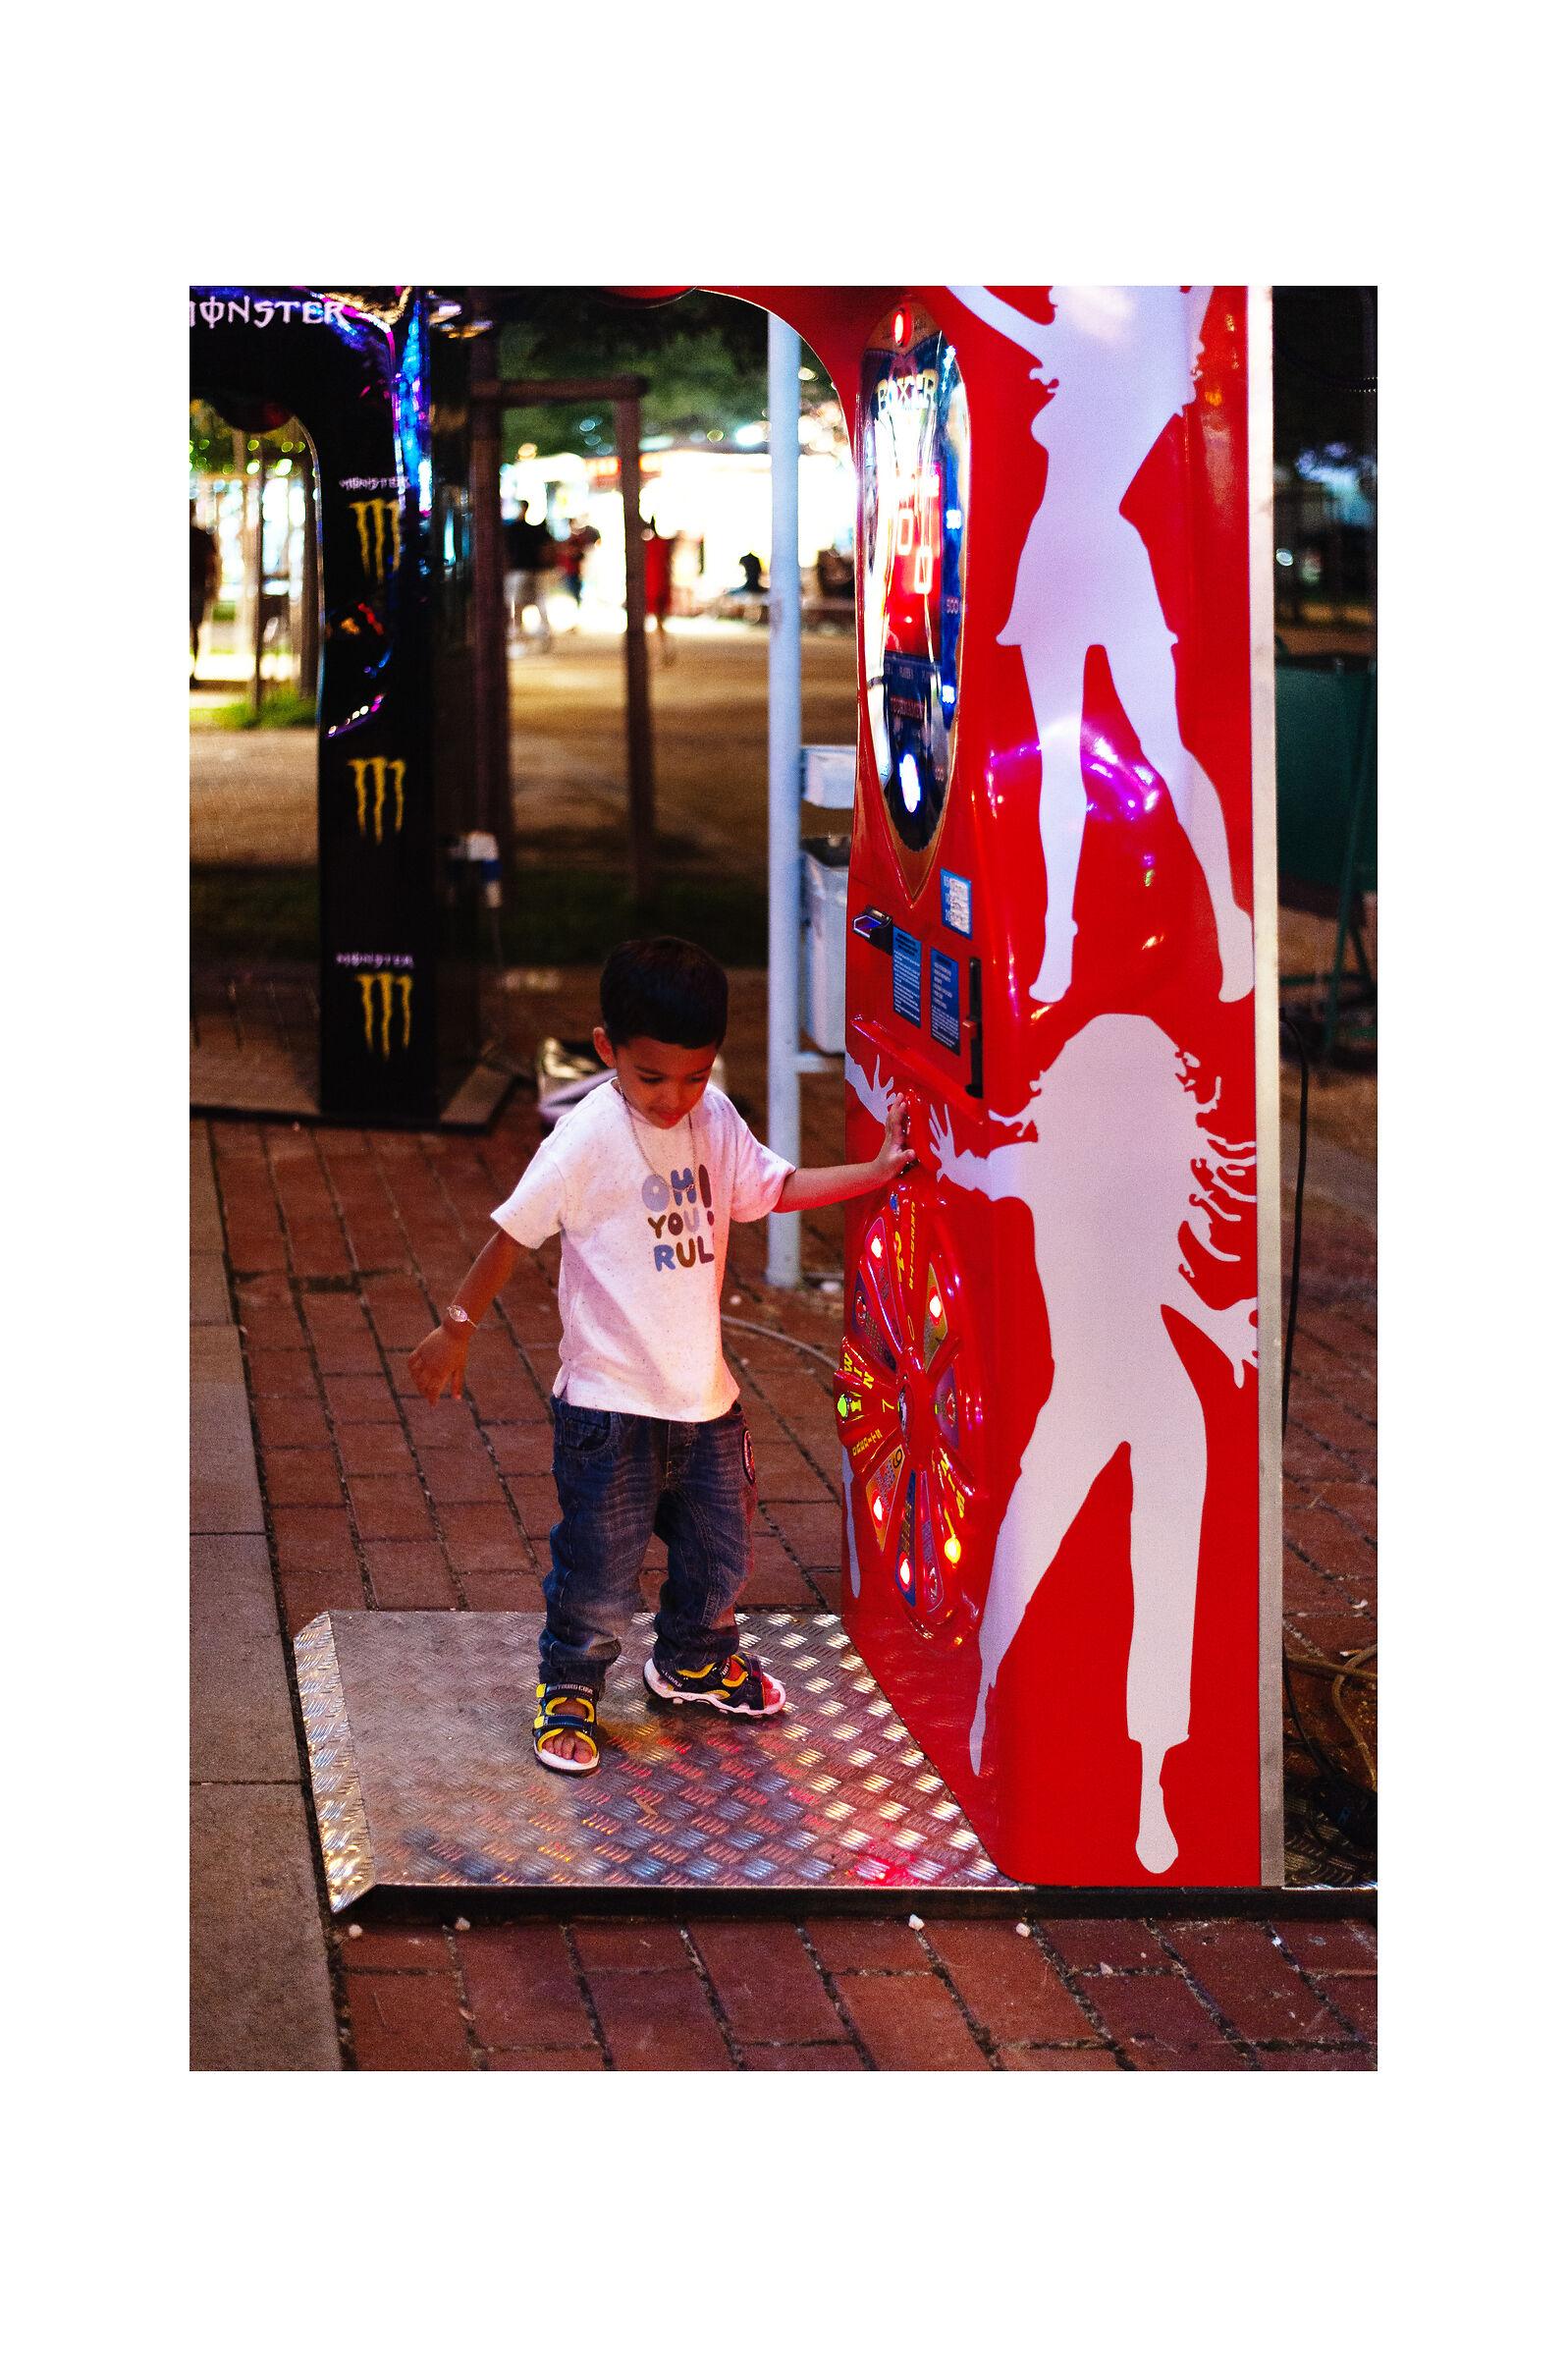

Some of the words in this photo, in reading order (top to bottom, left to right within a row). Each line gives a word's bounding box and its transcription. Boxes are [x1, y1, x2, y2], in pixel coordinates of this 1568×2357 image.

[641, 1164, 715, 1227] OH!
[647, 1207, 700, 1238] YOU
[654, 1235, 715, 1272] RUL
[843, 1352, 875, 1390] WIN
[882, 1398, 895, 1412] 7
